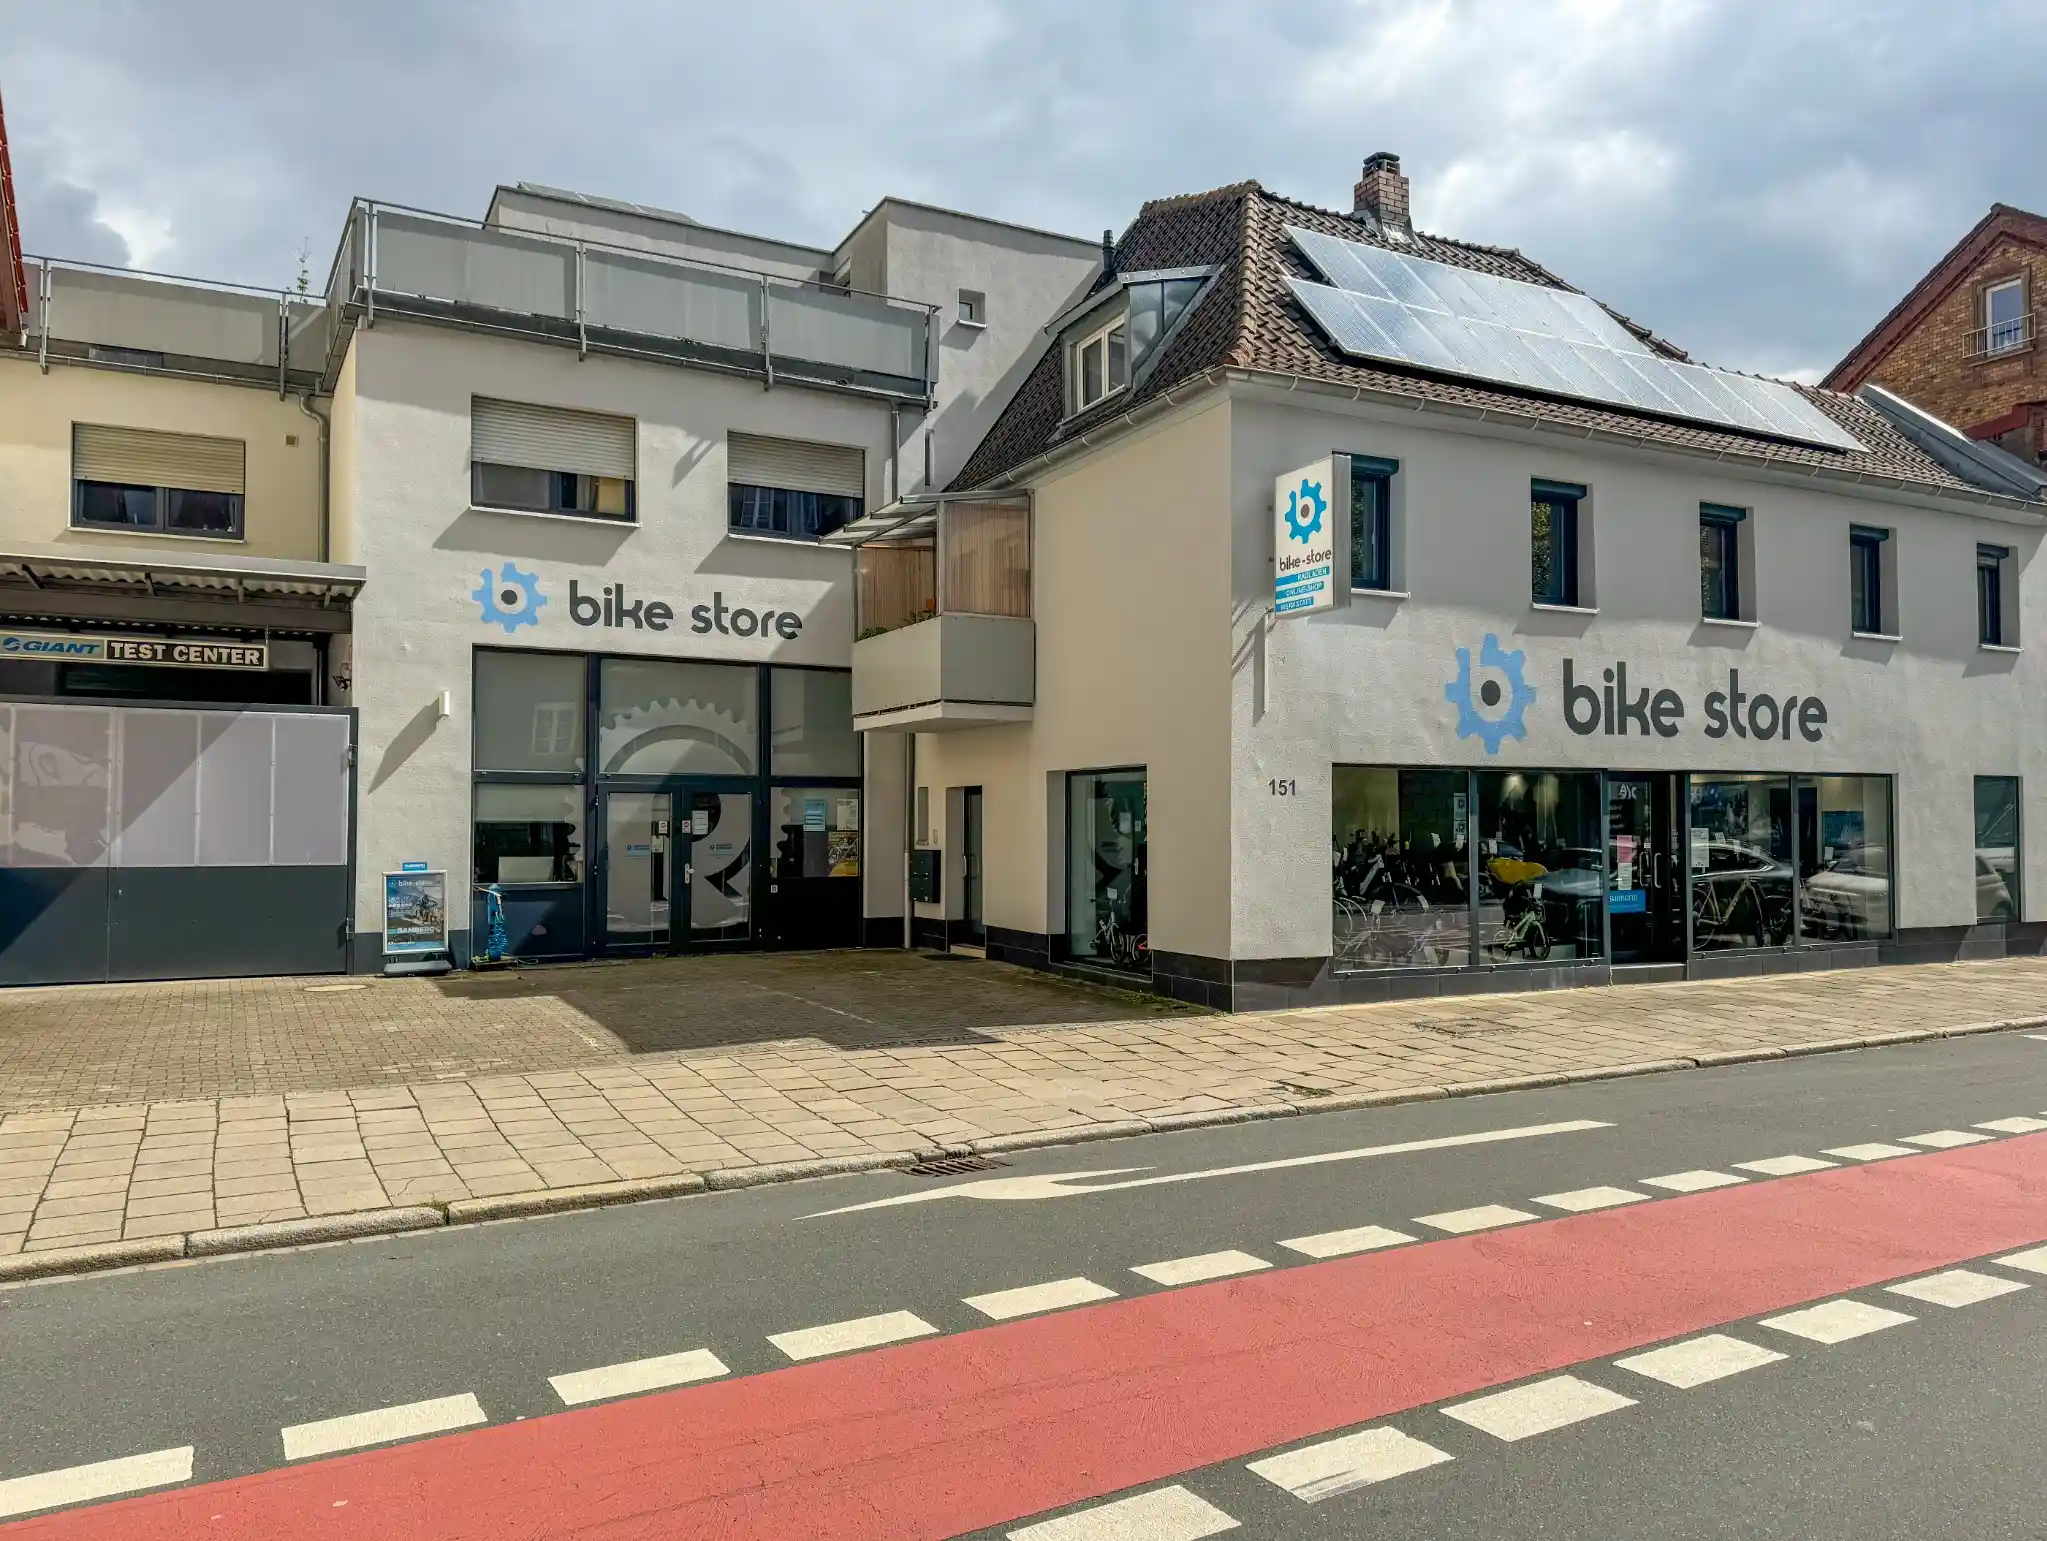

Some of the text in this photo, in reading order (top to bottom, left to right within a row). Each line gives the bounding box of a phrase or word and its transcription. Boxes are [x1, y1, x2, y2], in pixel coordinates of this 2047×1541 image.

[1279, 549, 1332, 572] bike-store
[1297, 567, 1327, 581] RADLADEN
[569, 579, 674, 631] bike
[691, 591, 803, 640] store
[1280, 597, 1312, 611] WERKSTATT
[22, 640, 261, 665] GIANT TEST CENTER
[1562, 658, 1685, 738] bike
[1703, 668, 1828, 743] store
[1268, 778, 1296, 797] 151
